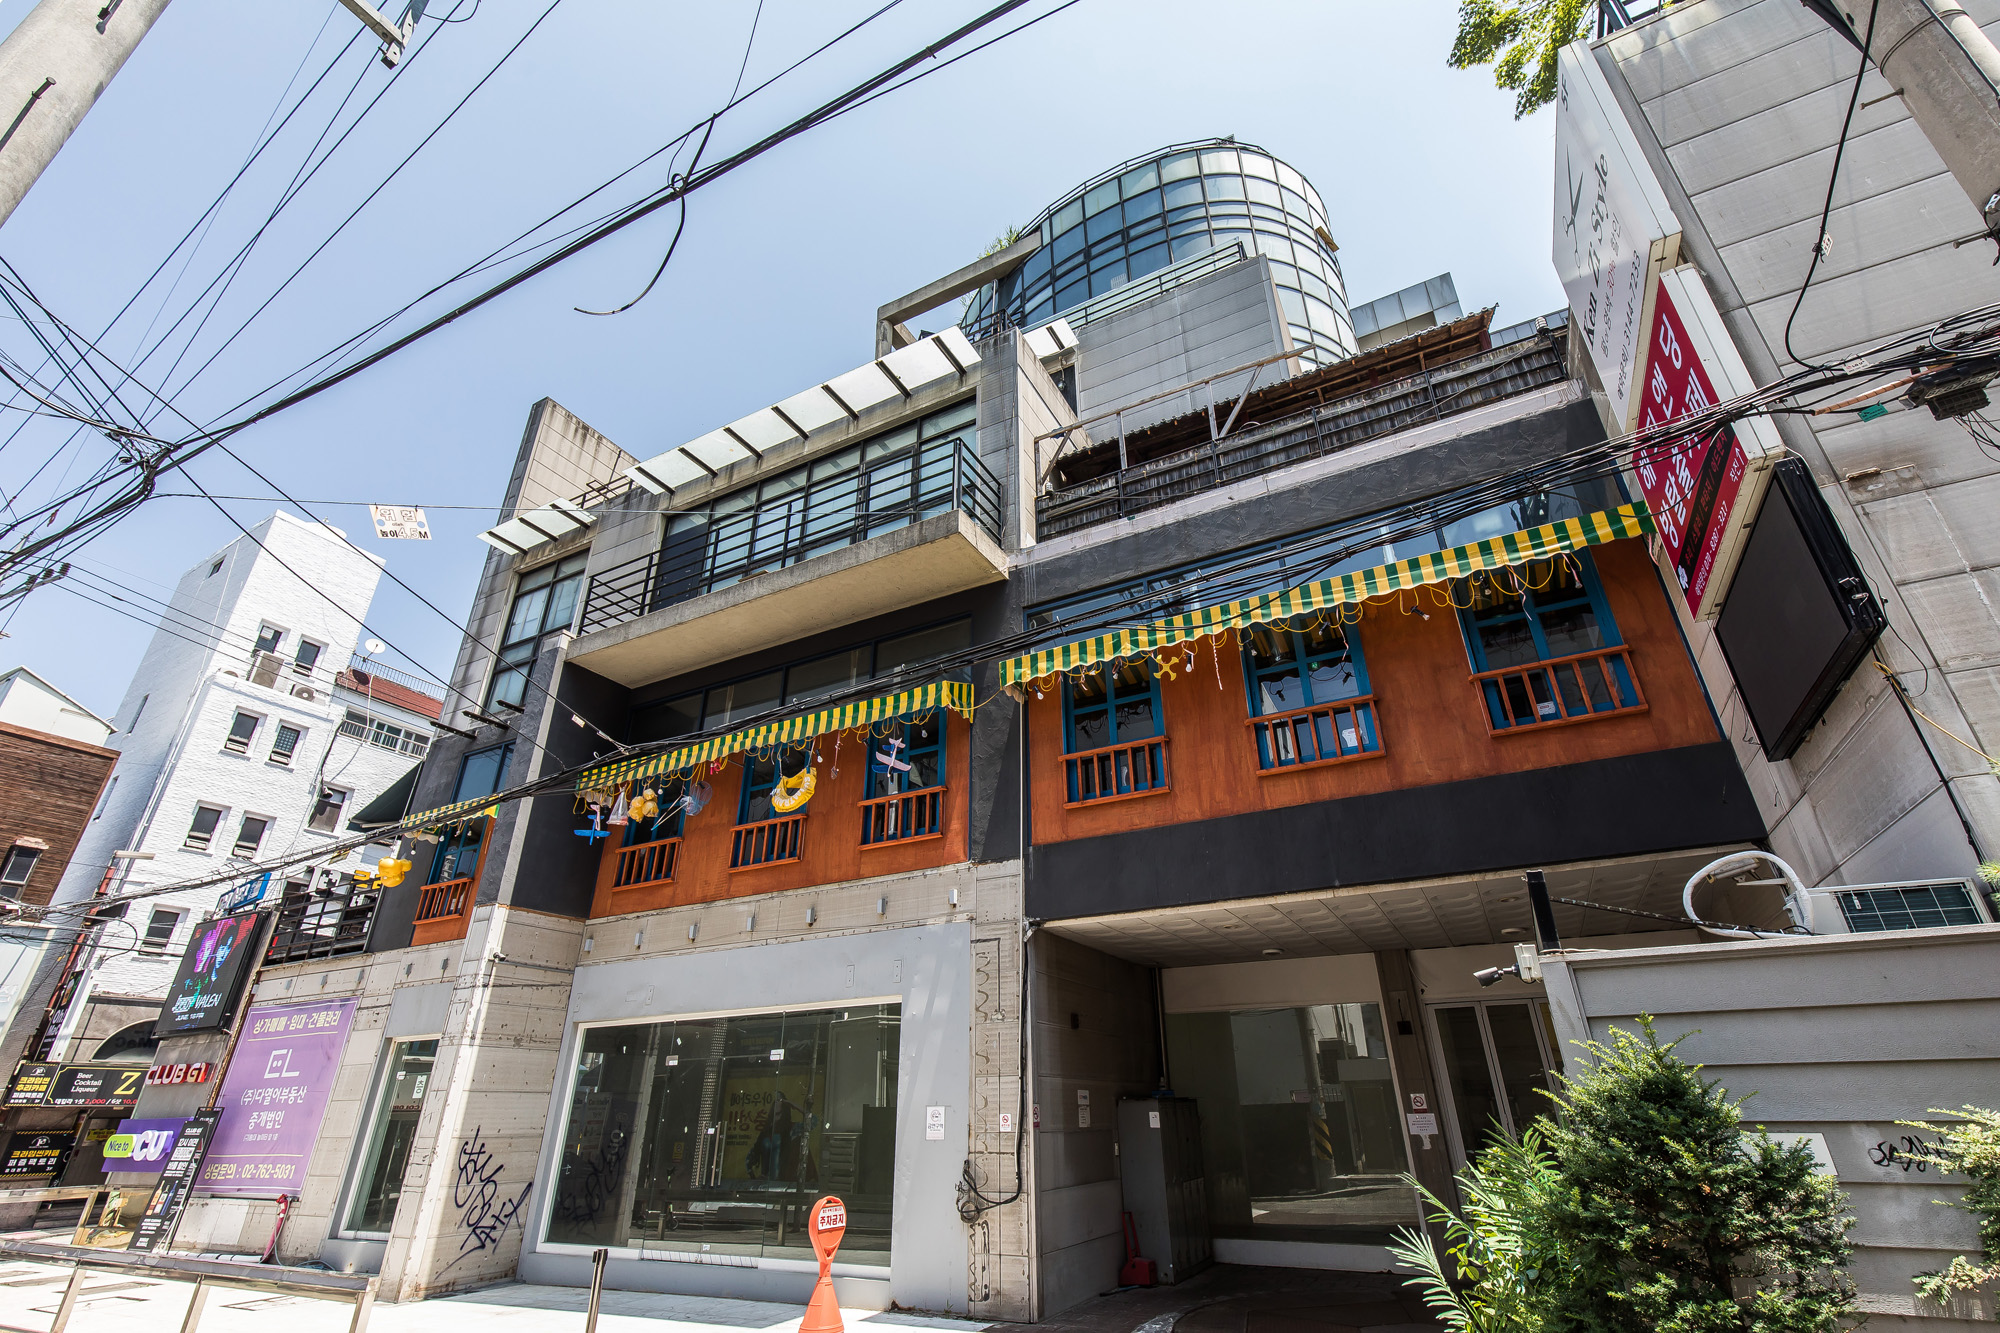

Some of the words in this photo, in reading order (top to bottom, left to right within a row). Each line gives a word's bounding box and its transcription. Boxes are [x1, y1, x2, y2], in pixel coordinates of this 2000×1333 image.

[1560, 72, 1570, 112] 5F
[1590, 153, 1609, 246] Style
[1587, 240, 1600, 289] Zi
[1624, 249, 1641, 347] 3144-7233
[1583, 291, 1597, 352] Ken
[113, 1072, 141, 1095] Z
[145, 1063, 188, 1085] CLUB
[248, 1110, 285, 1130] 중개법인
[107, 1140, 121, 1152] Nice
[121, 1141, 129, 1151] to
[133, 1130, 172, 1162] CU
[241, 1164, 296, 1179] 02-762-5031
[820, 1213, 844, 1227] 주차금지
